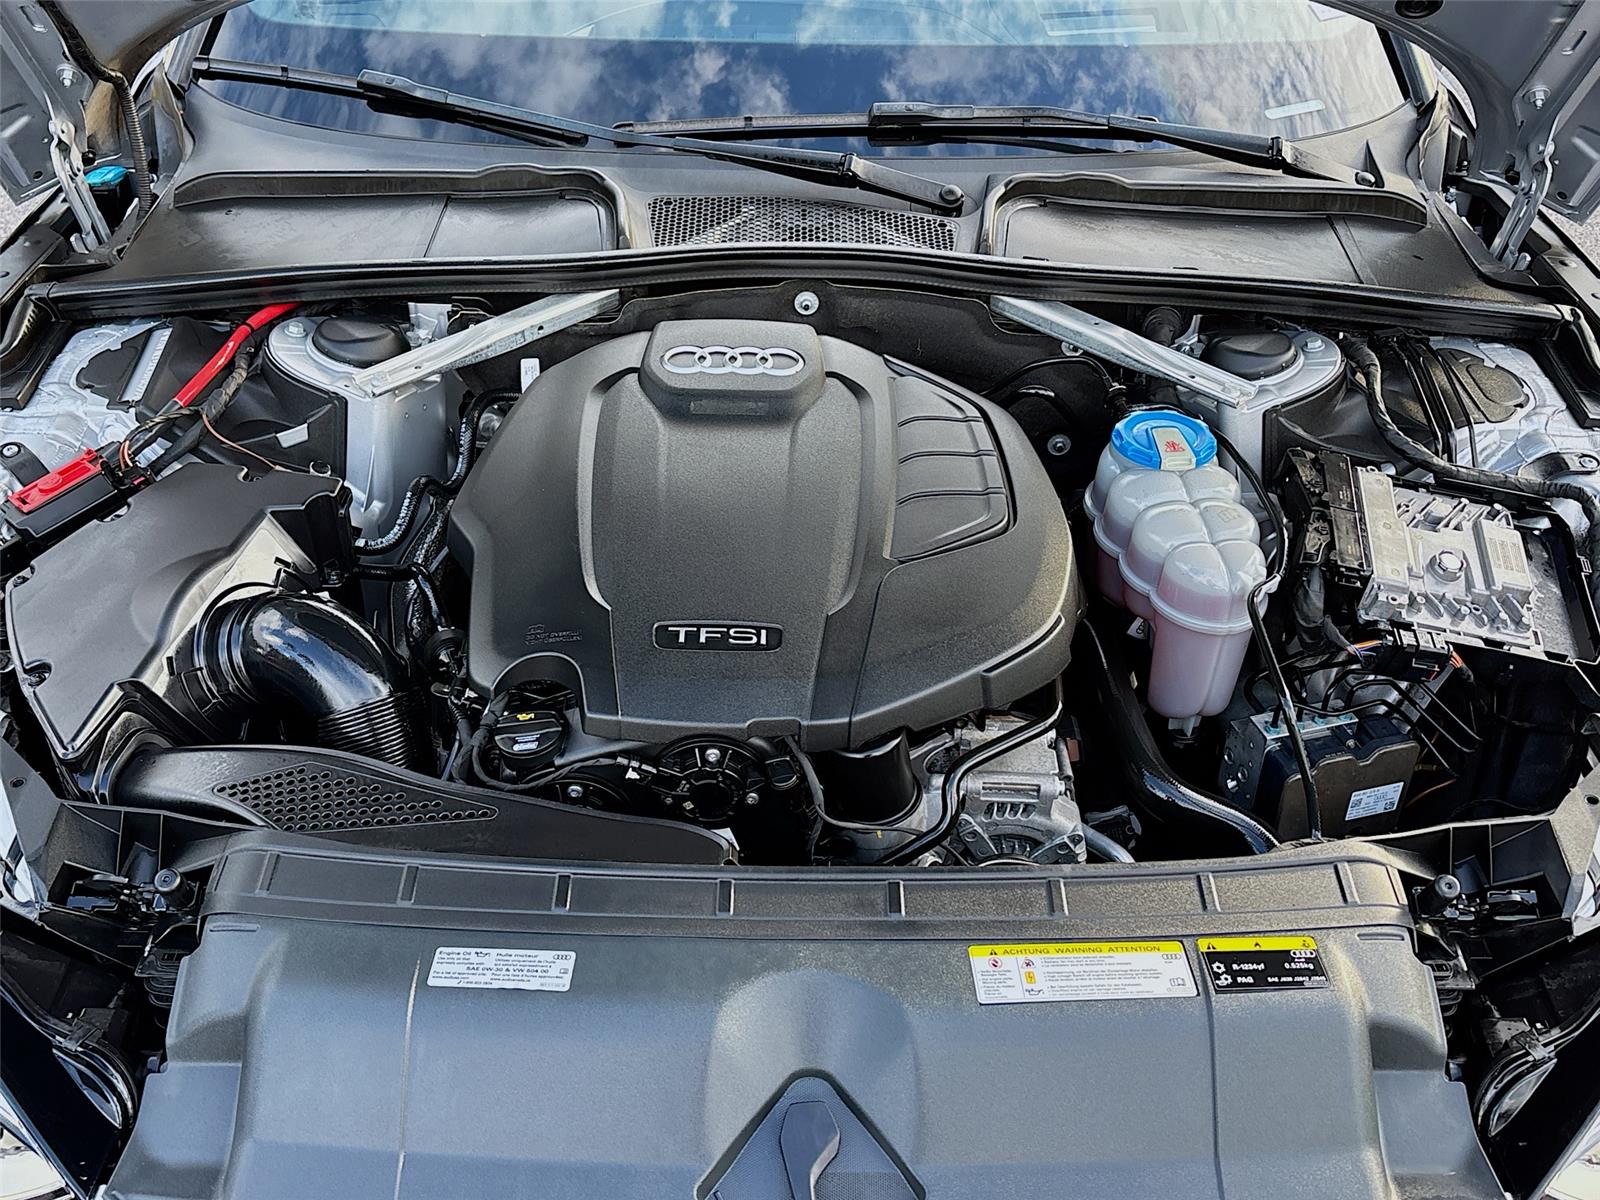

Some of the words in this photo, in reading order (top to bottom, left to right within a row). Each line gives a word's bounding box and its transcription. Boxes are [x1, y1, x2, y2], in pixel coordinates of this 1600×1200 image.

[667, 626, 767, 645] TFSI
[1003, 947, 1050, 955] ACHTUNG
[1054, 946, 1103, 954] WARNING
[1108, 945, 1161, 953] ATTENTION
[1231, 962, 1265, 971] R-1234yf
[1284, 962, 1315, 970] 0.525kg
